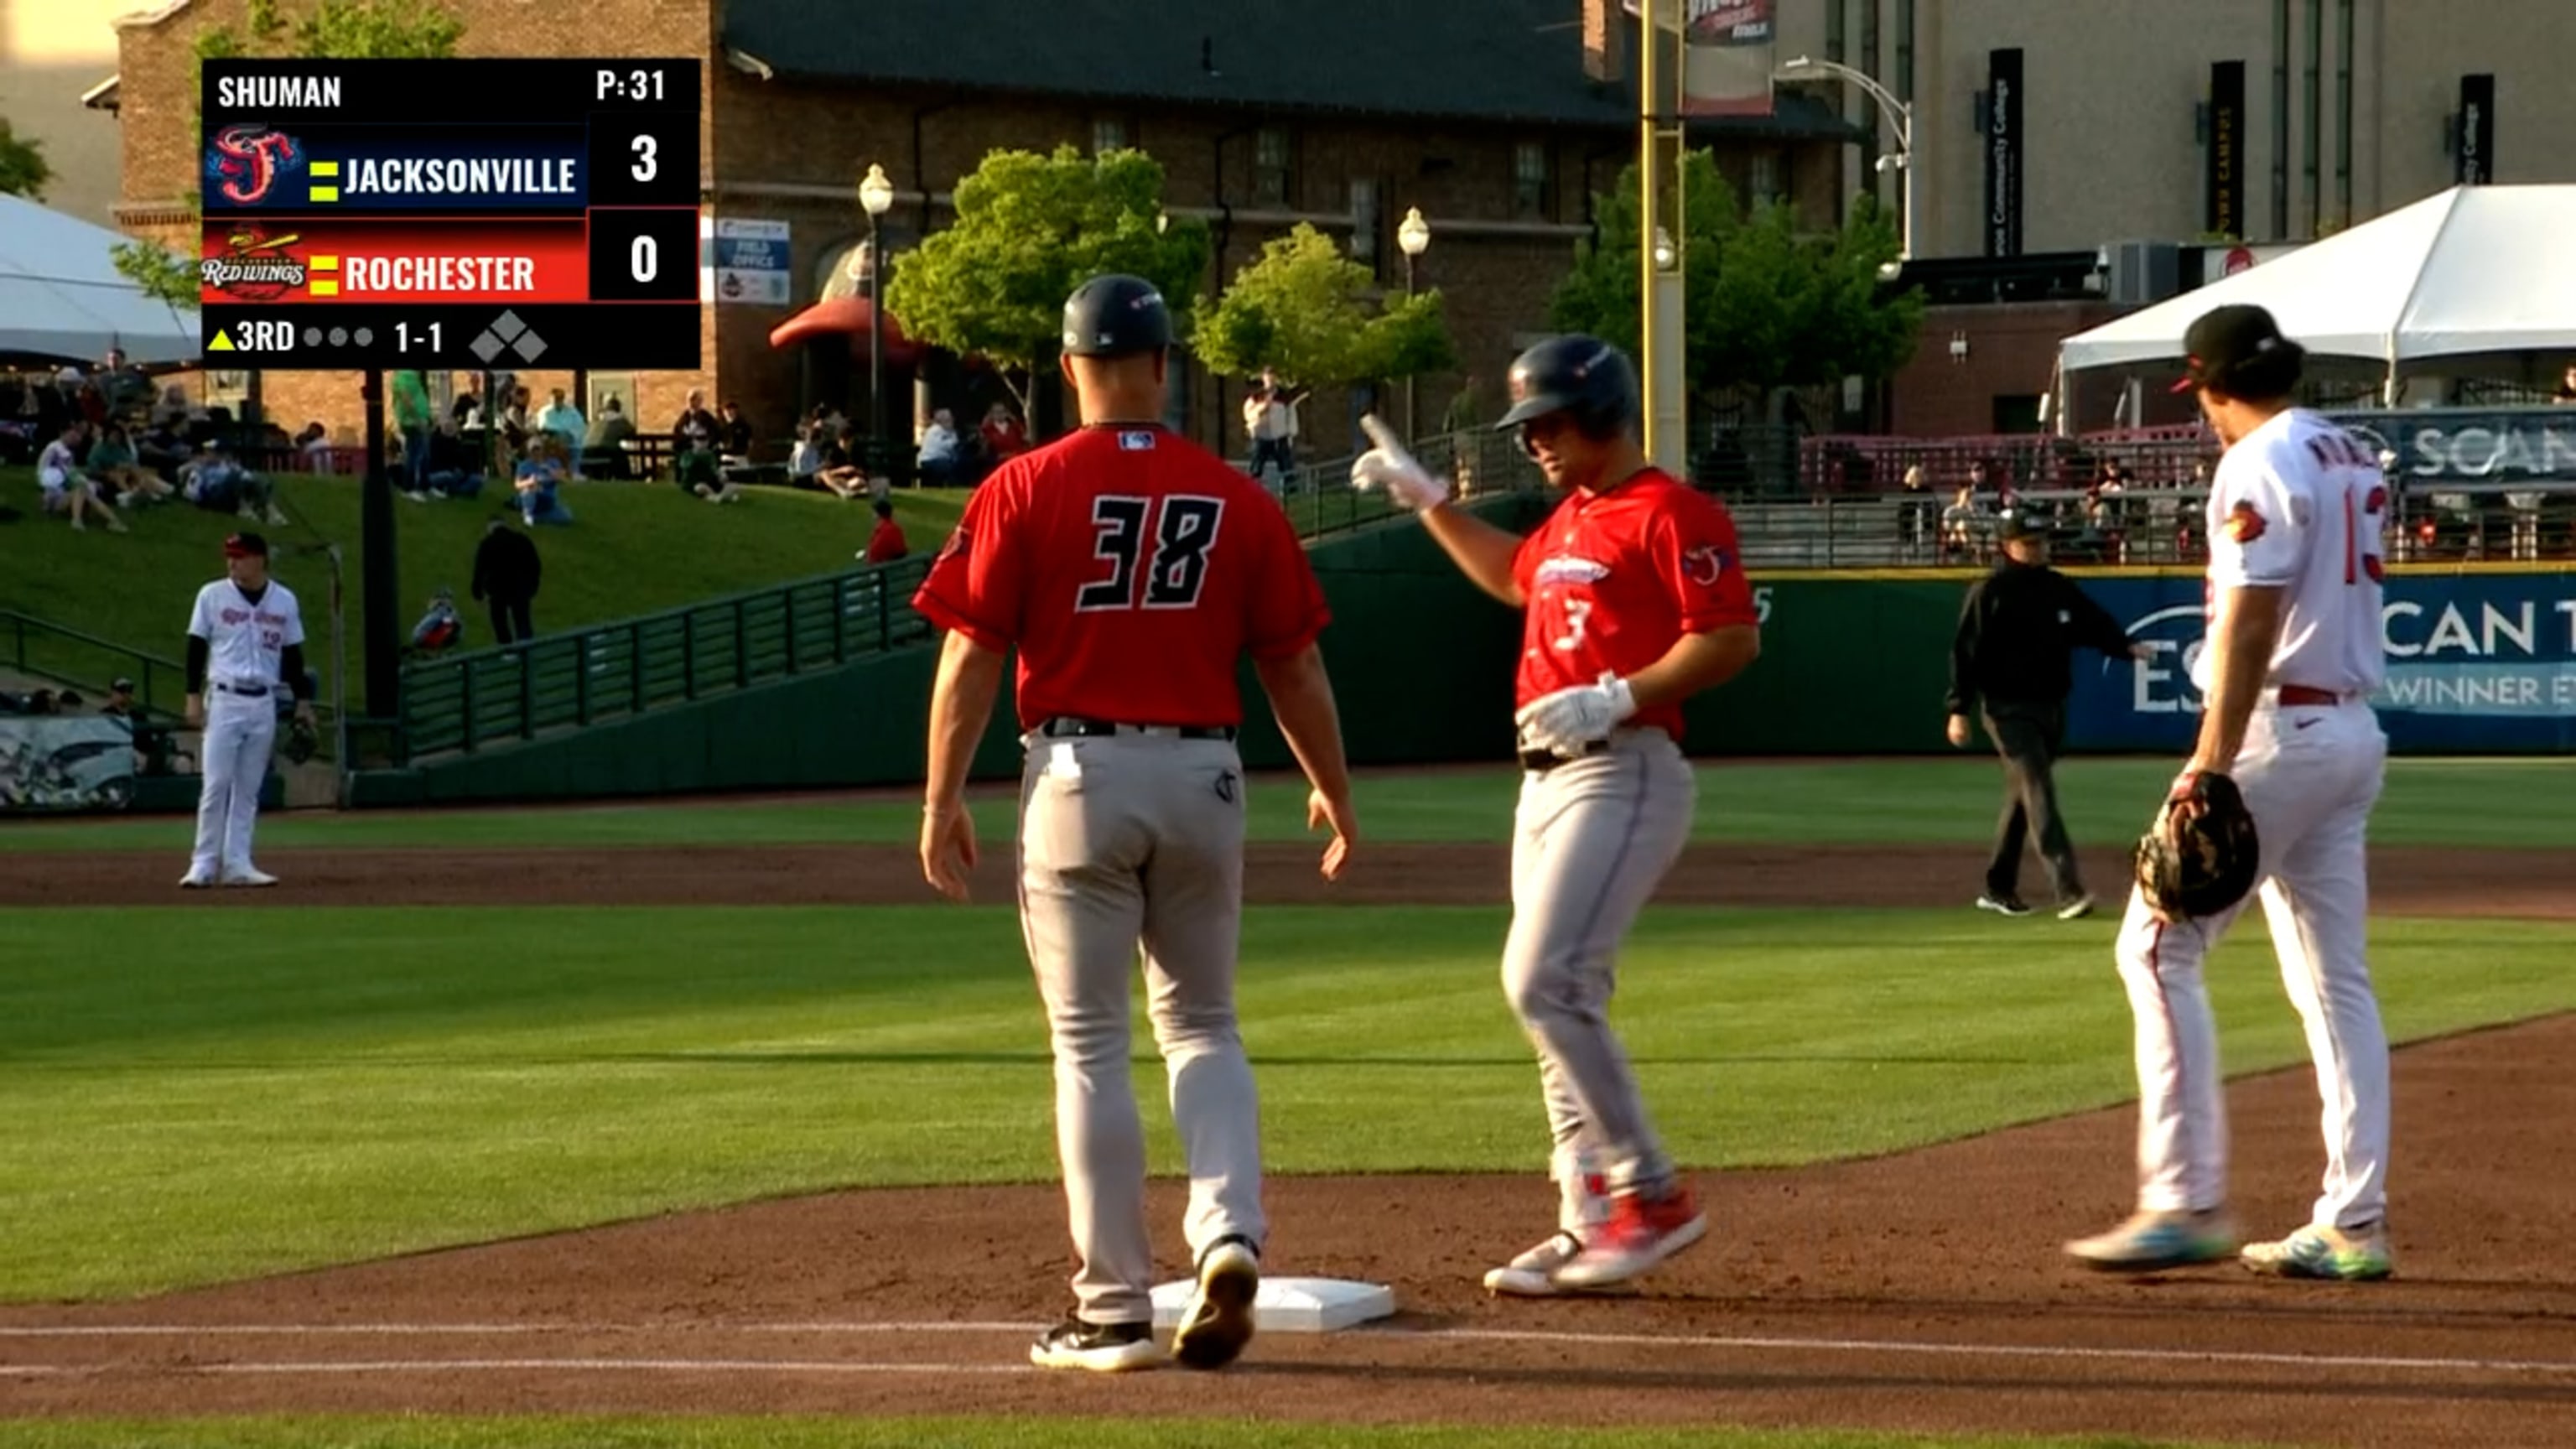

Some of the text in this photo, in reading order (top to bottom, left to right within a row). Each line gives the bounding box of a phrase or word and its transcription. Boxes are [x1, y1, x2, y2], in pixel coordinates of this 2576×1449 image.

[1992, 78, 2009, 133] College
[1992, 137, 2009, 224] Community
[1074, 494, 1226, 614] 38
[1554, 596, 1592, 651] 3
[2386, 677, 2542, 704] WINNER
